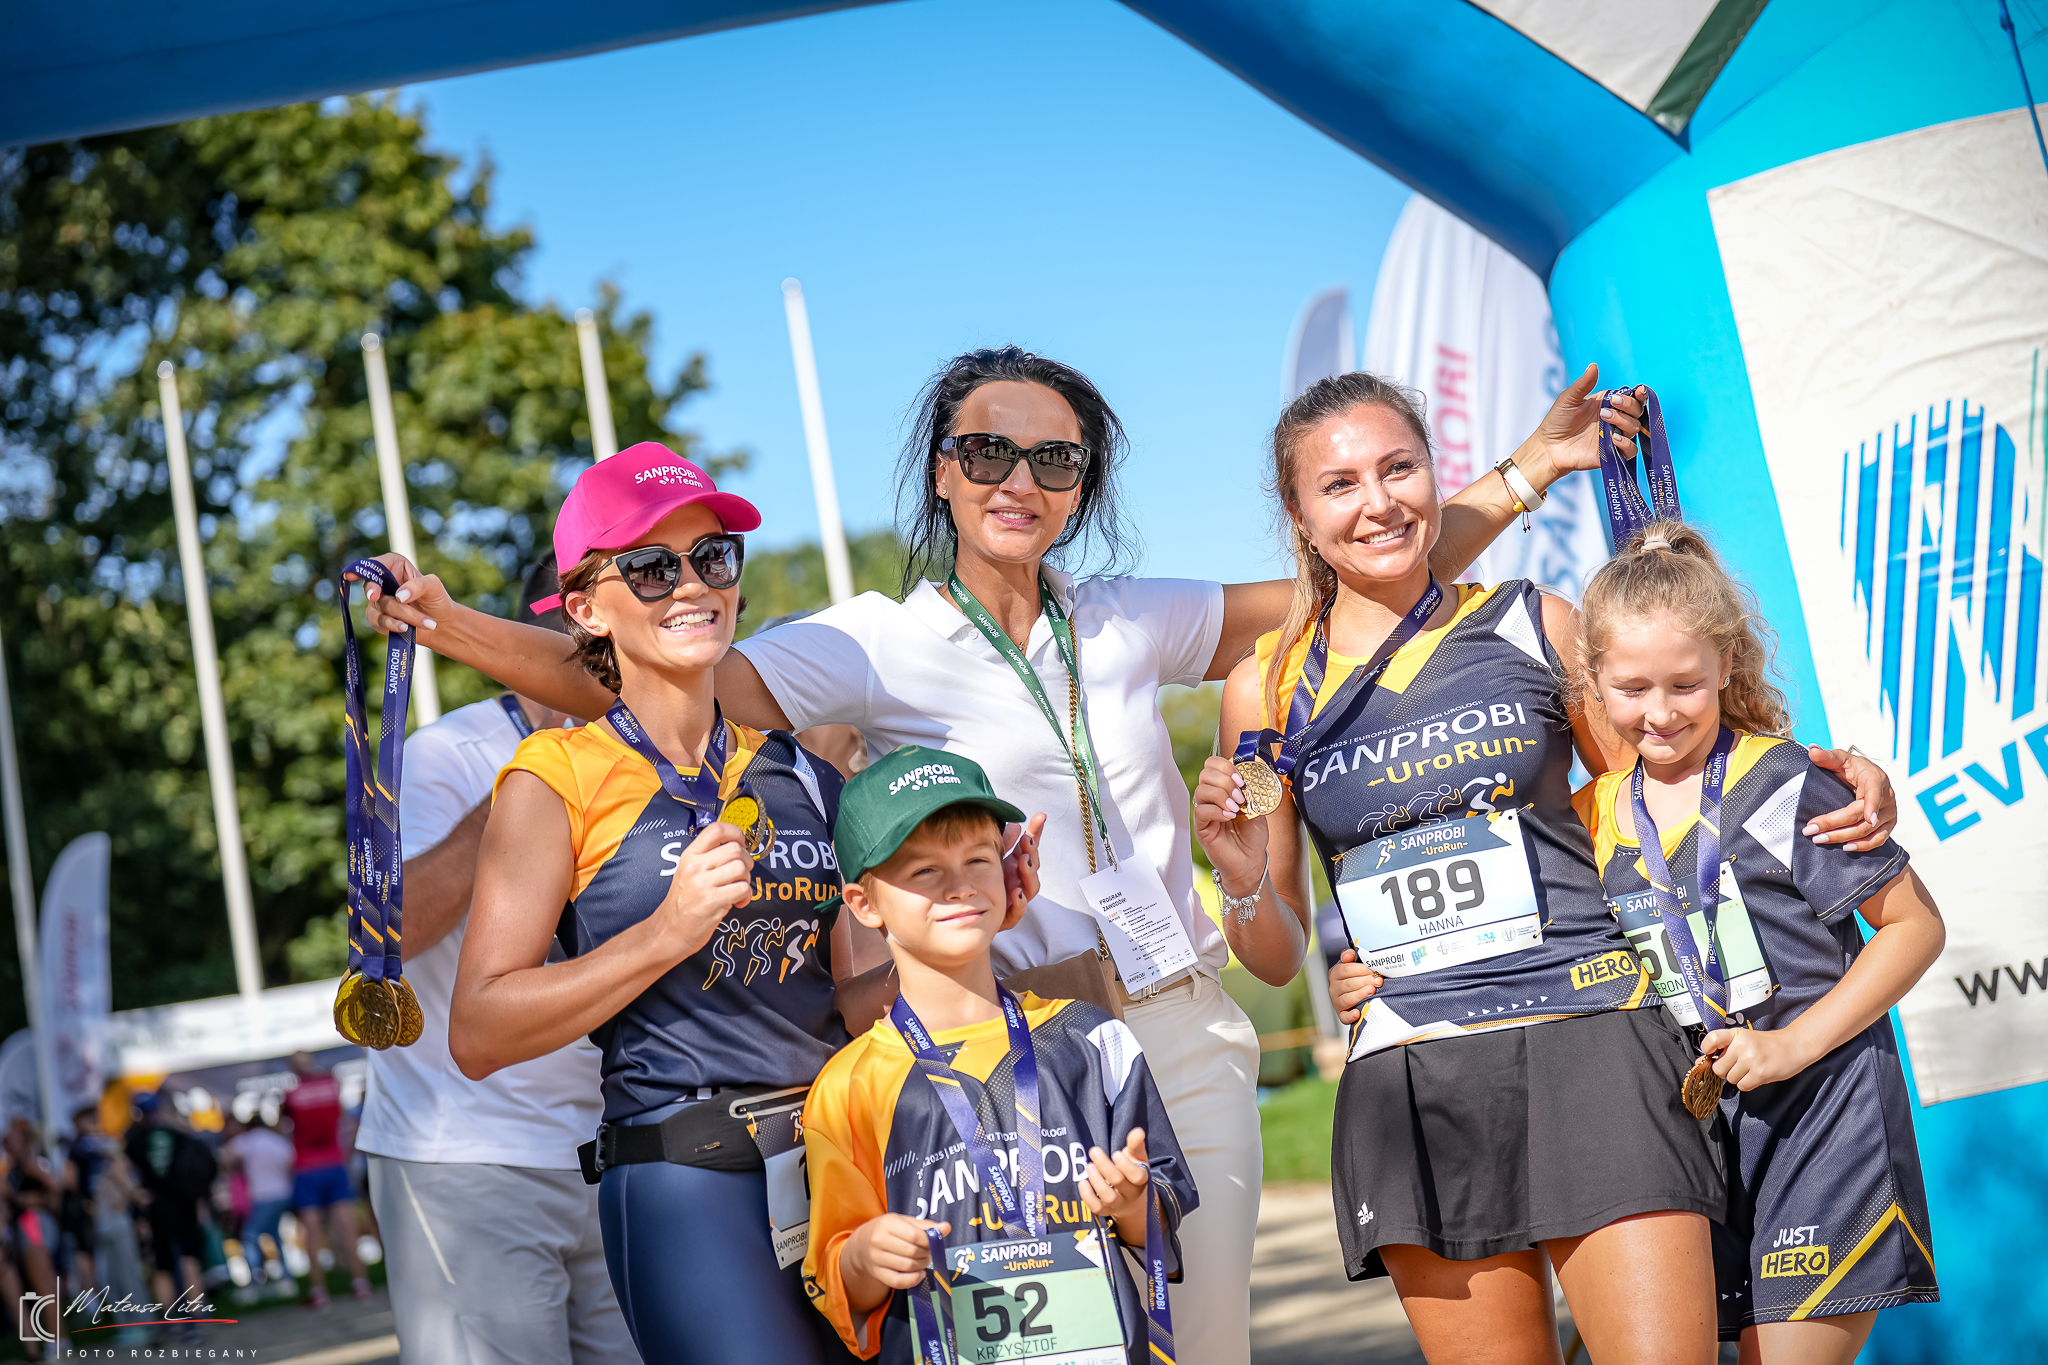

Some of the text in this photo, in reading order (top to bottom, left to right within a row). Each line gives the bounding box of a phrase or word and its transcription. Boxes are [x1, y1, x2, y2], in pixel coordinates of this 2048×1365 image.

[634, 465, 698, 485] SANPROBI
[676, 476, 703, 489] Team
[1661, 464, 1676, 507] SANPROBI
[950, 579, 970, 605] SANPROBI
[976, 613, 1001, 639] SANPROBI
[388, 648, 400, 695] SANPROBI
[1006, 648, 1031, 675] SANPROBI
[612, 711, 641, 744] SANPROBI
[1308, 740, 1348, 758] 20.09.2025
[1353, 724, 1405, 743] EUROPEJSKI
[1444, 700, 1484, 716] UROLOGII
[1078, 743, 1093, 778] SANPROBI
[1303, 702, 1526, 793] SANPROBI
[888, 763, 955, 796] SANPROBI
[929, 774, 962, 786] Team
[1710, 752, 1724, 787] SANPROBI
[1400, 825, 1466, 851] SANPROBI
[363, 837, 374, 886] SANPROBI
[1380, 859, 1485, 927] 189
[1418, 915, 1464, 936] HANNA
[1365, 953, 1405, 968] SANPROBI
[1577, 956, 1633, 983] HERO
[1680, 955, 1703, 998] SANPROBI
[904, 1017, 931, 1051] SANPROBI
[987, 1165, 1016, 1212] SANPROBI
[775, 1231, 808, 1253] SANPROBI
[1772, 1225, 1820, 1248] JUST
[979, 1241, 1053, 1265] SANPROBI
[1766, 1251, 1826, 1275] HERO
[1152, 1259, 1166, 1311] SANPROBI
[971, 1281, 1054, 1343] 52
[976, 1337, 1058, 1361] KRZYSZTOF
